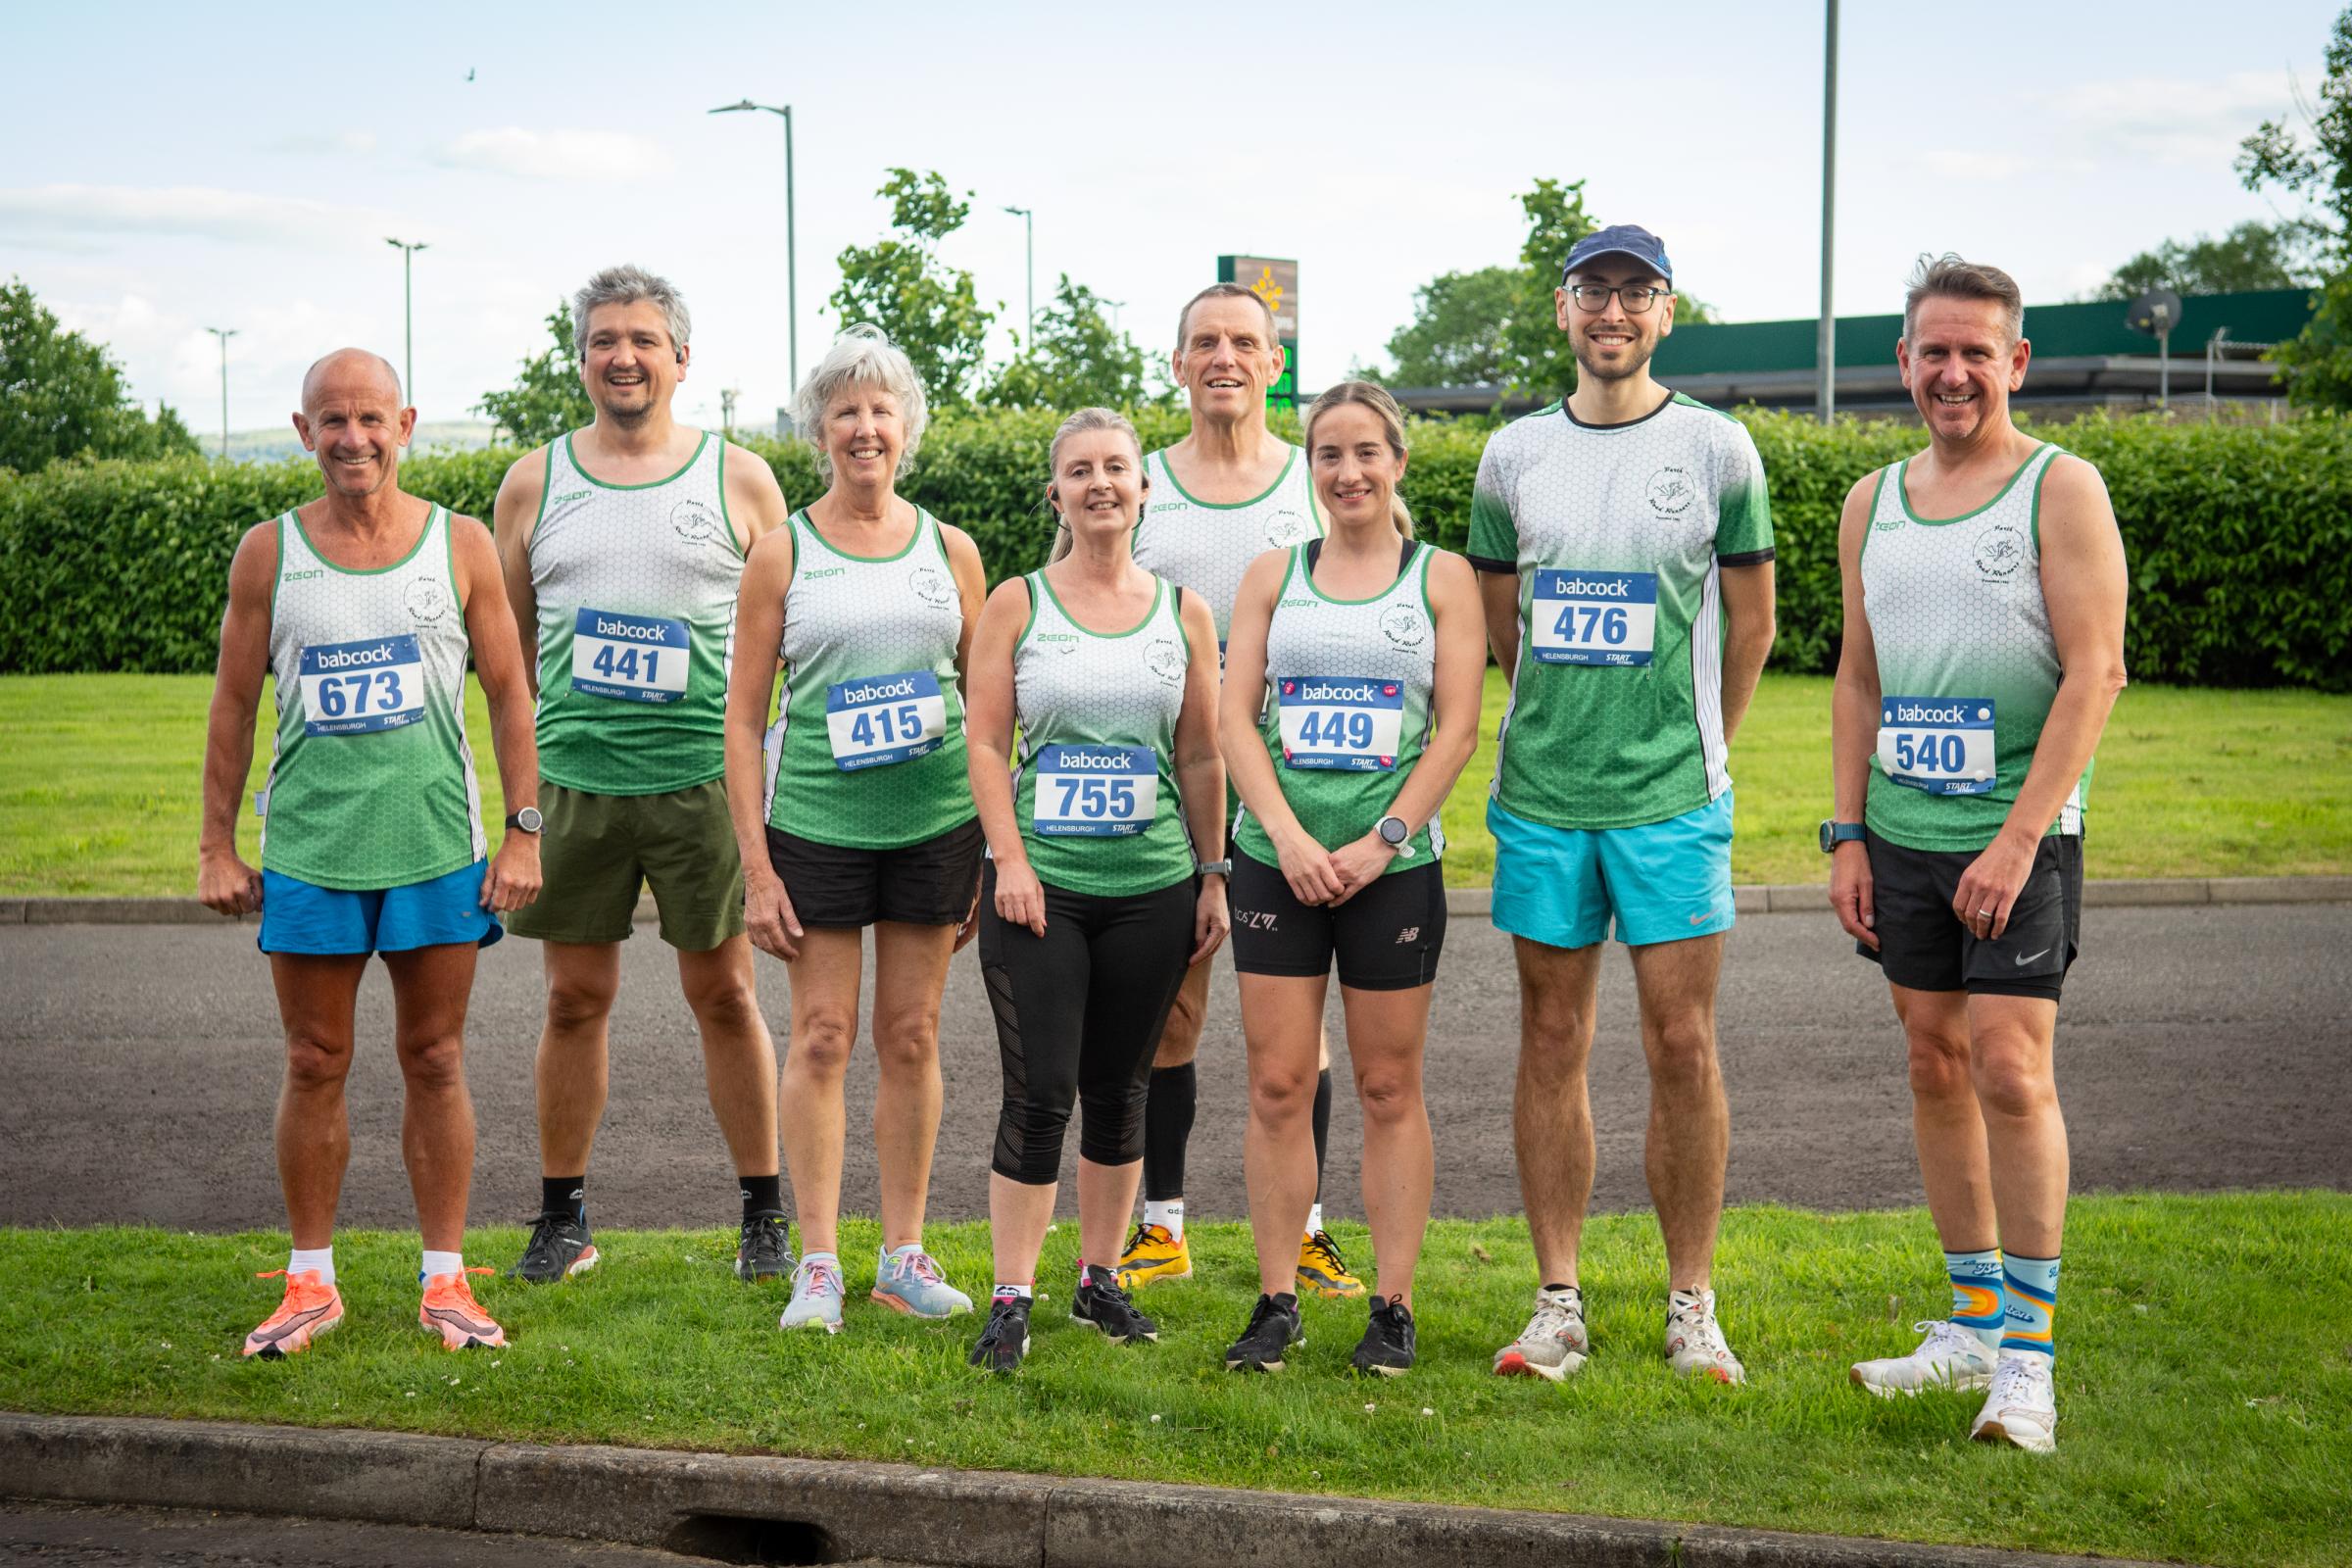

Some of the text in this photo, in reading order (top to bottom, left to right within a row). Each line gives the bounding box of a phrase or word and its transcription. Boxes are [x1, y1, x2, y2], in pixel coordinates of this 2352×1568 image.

[1556, 576, 1629, 597] babcock
[597, 616, 665, 642] babcock
[1553, 606, 1628, 645] 476
[318, 643, 393, 669] babcock
[593, 644, 659, 683] 441
[1542, 652, 1589, 662] HELENSBURGH
[1605, 653, 1632, 662] START
[318, 670, 404, 717] 673
[581, 684, 626, 697] HELENSBURGH
[641, 690, 666, 700] START
[844, 678, 915, 705] babcock
[1301, 682, 1374, 703] babcock
[383, 713, 407, 726] START
[1897, 704, 1965, 724] babcock
[317, 721, 367, 733] HELENSBURGH
[851, 704, 923, 747] 415
[1298, 710, 1374, 750] 449
[844, 753, 894, 768] HELENSBURGH
[1059, 751, 1132, 769] babcock
[1350, 758, 1376, 766] START
[1895, 733, 1966, 773] 540
[1945, 782, 1973, 791] START
[1054, 778, 1135, 818] 755
[1046, 824, 1096, 833] HELENSBURGH
[1112, 823, 1136, 833] START
